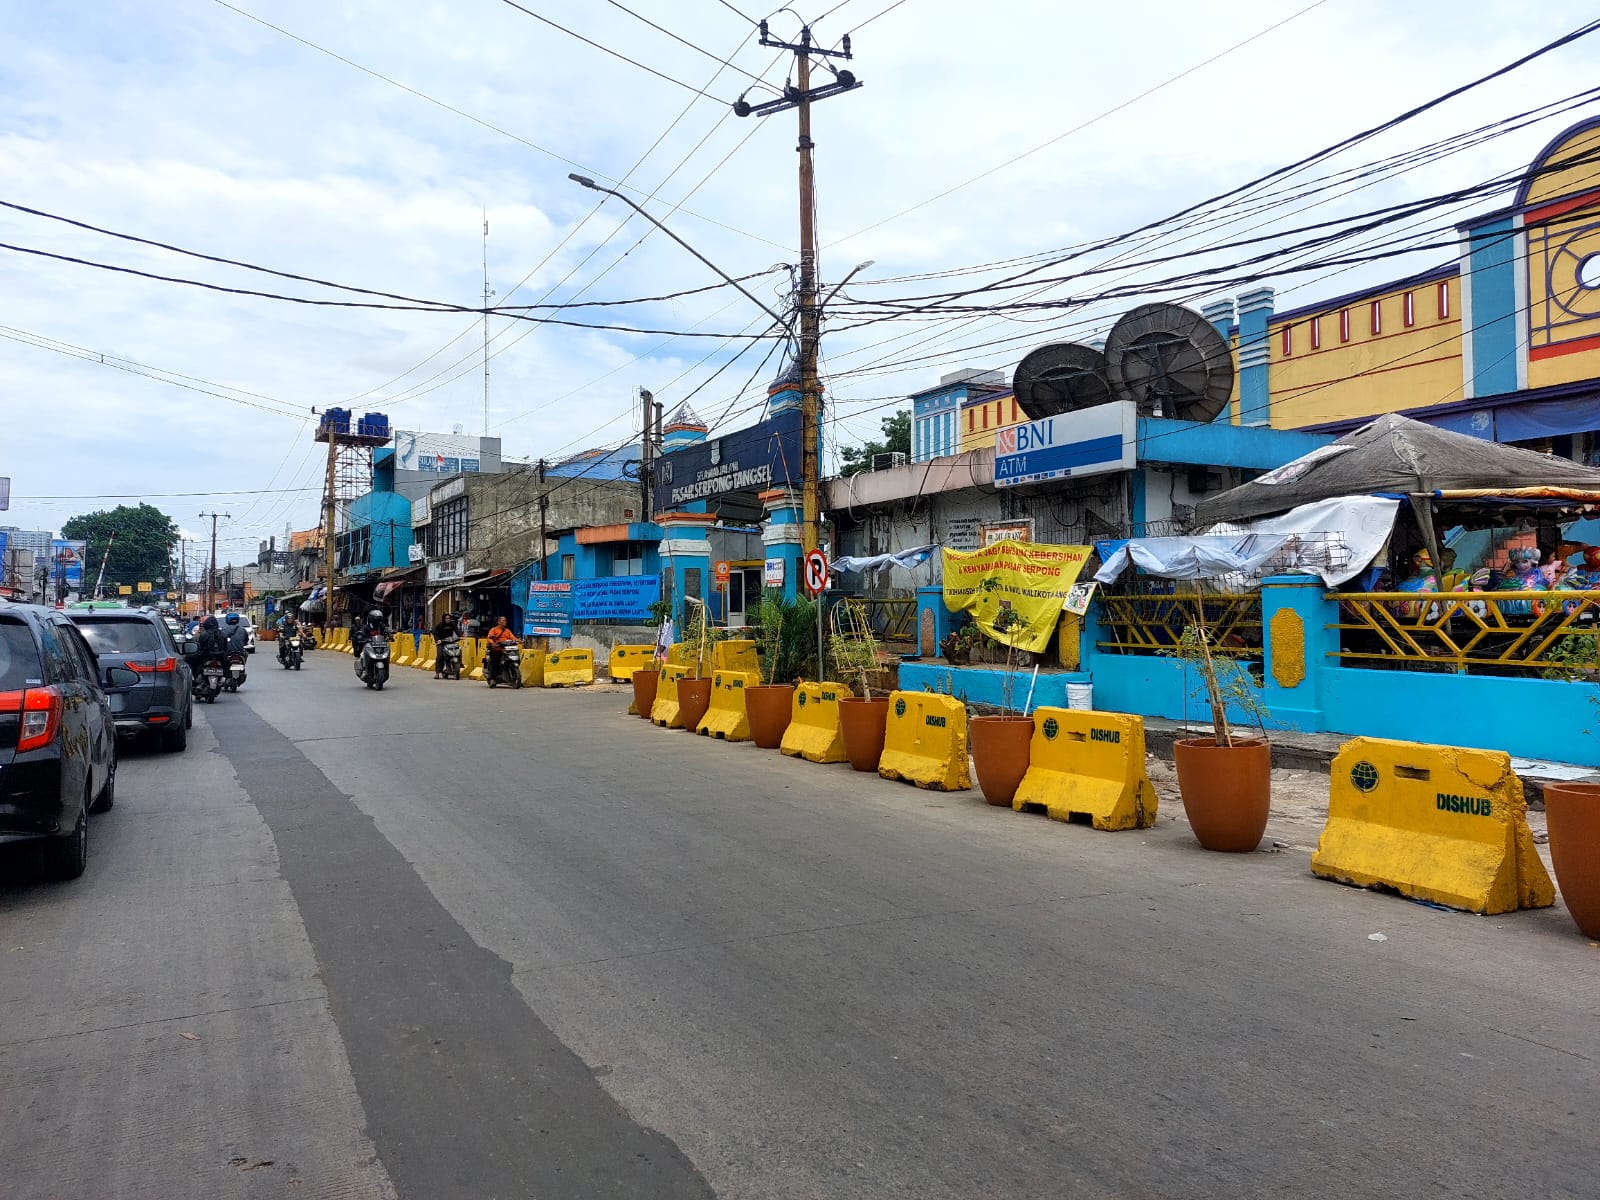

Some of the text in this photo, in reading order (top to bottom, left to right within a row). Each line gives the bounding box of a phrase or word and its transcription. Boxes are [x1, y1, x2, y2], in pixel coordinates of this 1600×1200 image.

[1017, 419, 1054, 451] BNI
[1000, 456, 1027, 476] ATM
[672, 464, 772, 504] PASAR SERPONG TANGSEL
[1029, 551, 1083, 562] KEBERSIHAN
[1023, 567, 1061, 577] SERPONG
[925, 715, 946, 729] DISHUB
[1090, 728, 1120, 744] DISHUB
[1436, 793, 1491, 817] DISHUB
